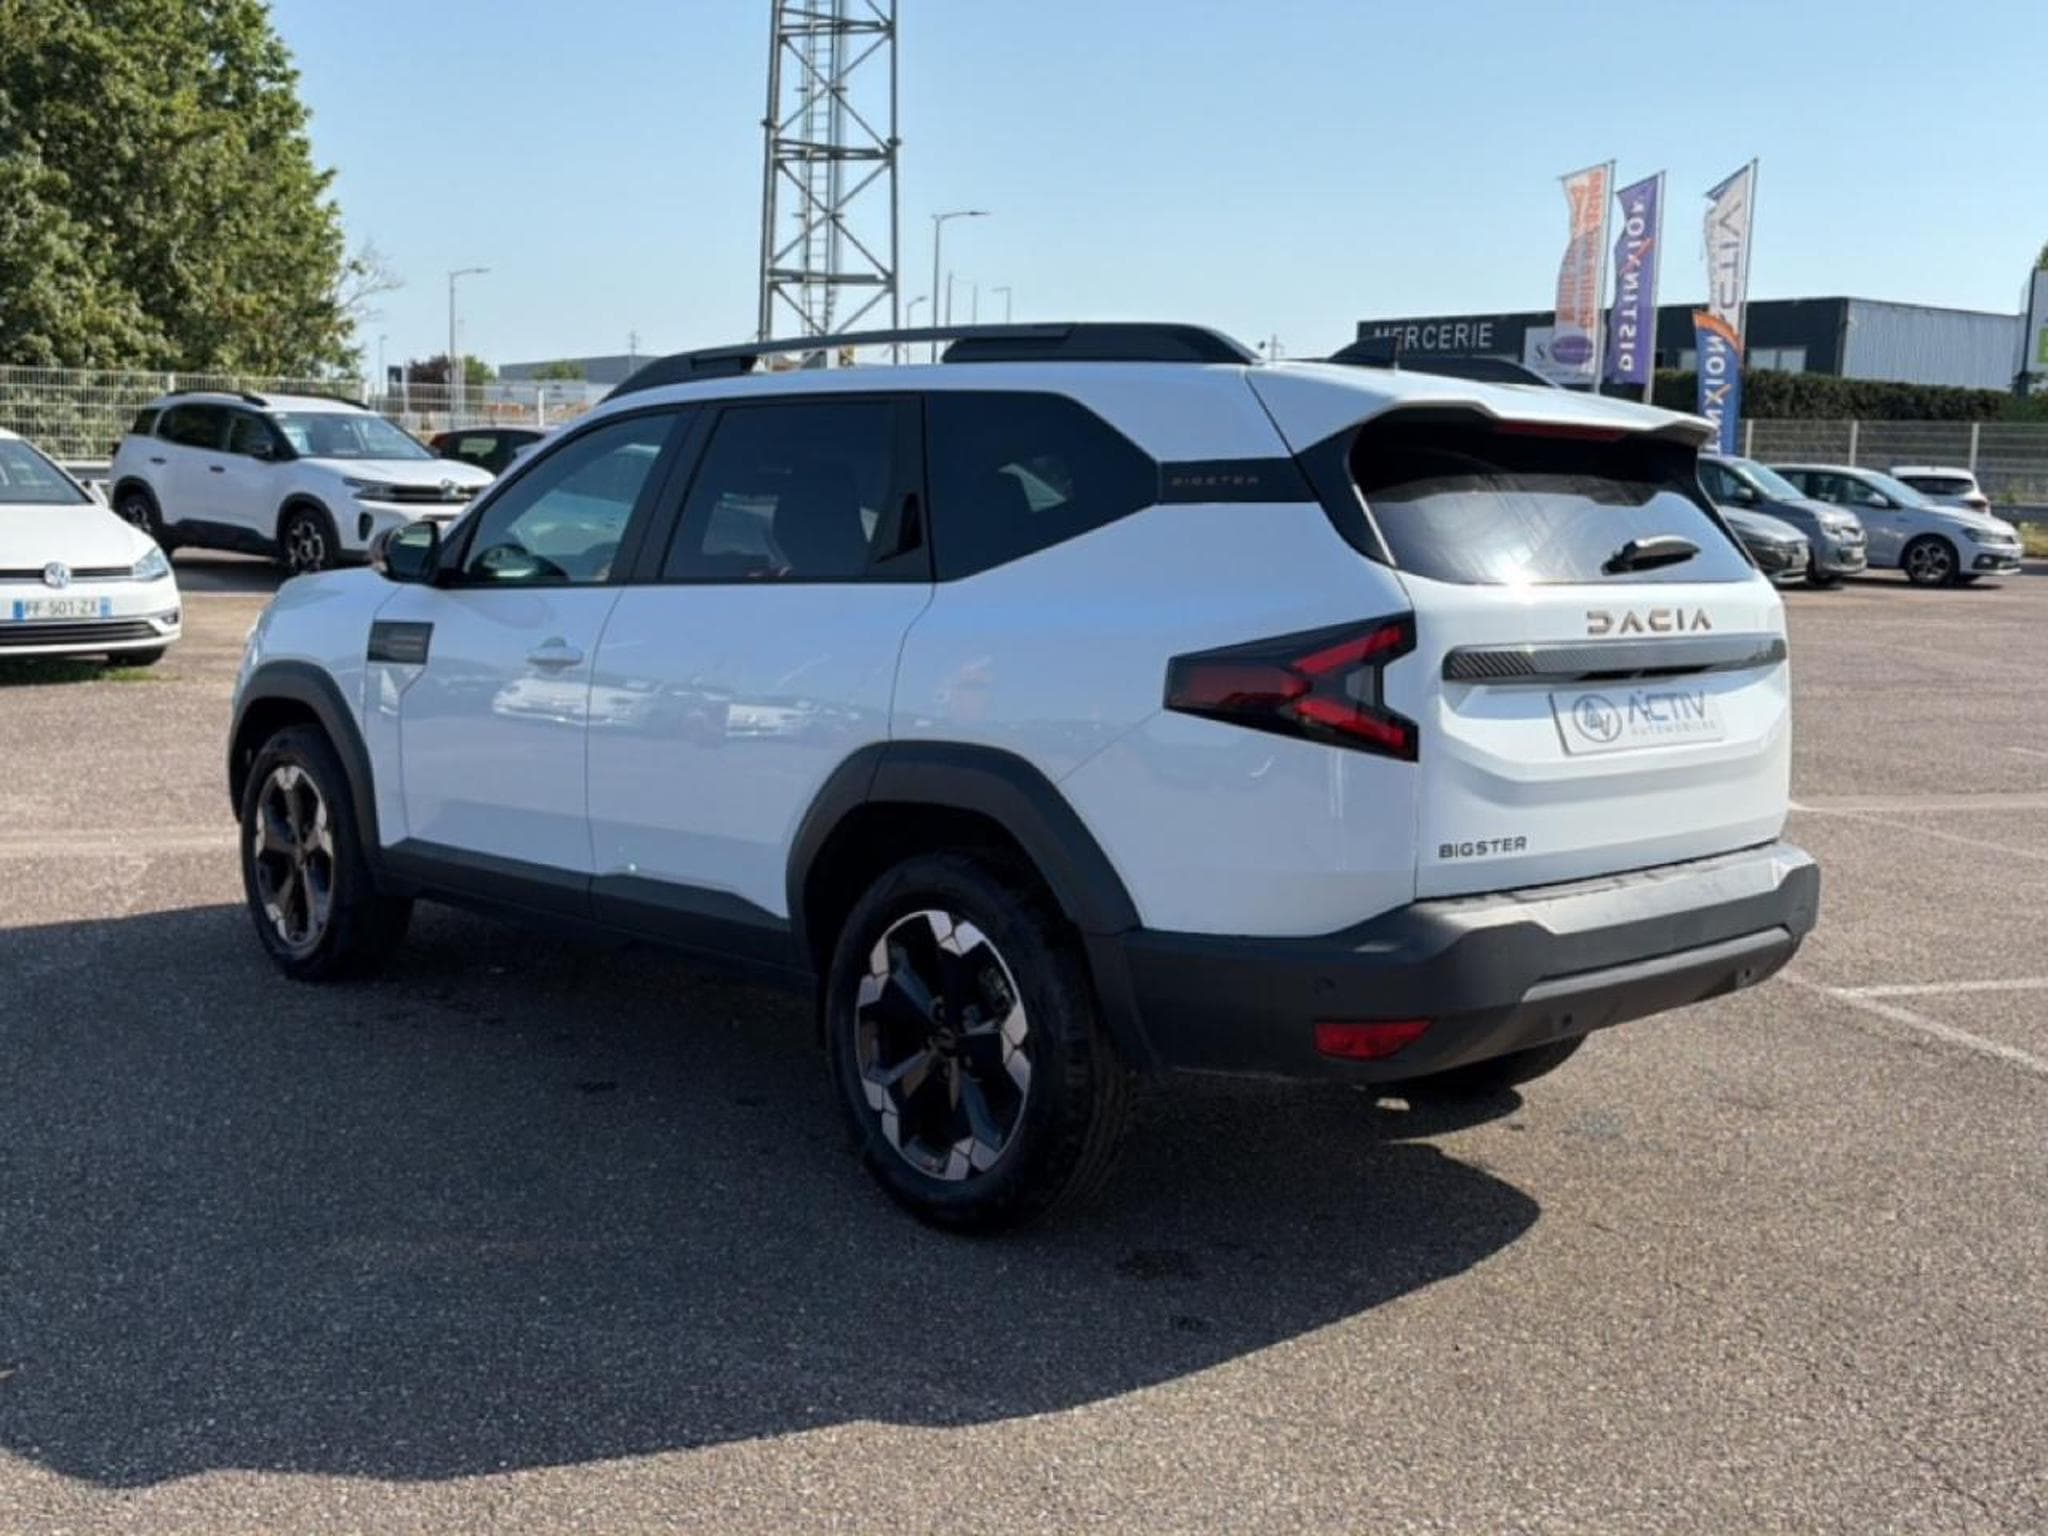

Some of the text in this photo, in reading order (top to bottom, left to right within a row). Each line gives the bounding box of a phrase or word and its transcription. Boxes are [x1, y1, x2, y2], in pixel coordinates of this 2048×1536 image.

[1586, 607, 1713, 636] DACIA
[1628, 689, 1706, 724] ACTIV
[1438, 835, 1528, 860] BIGSTER
